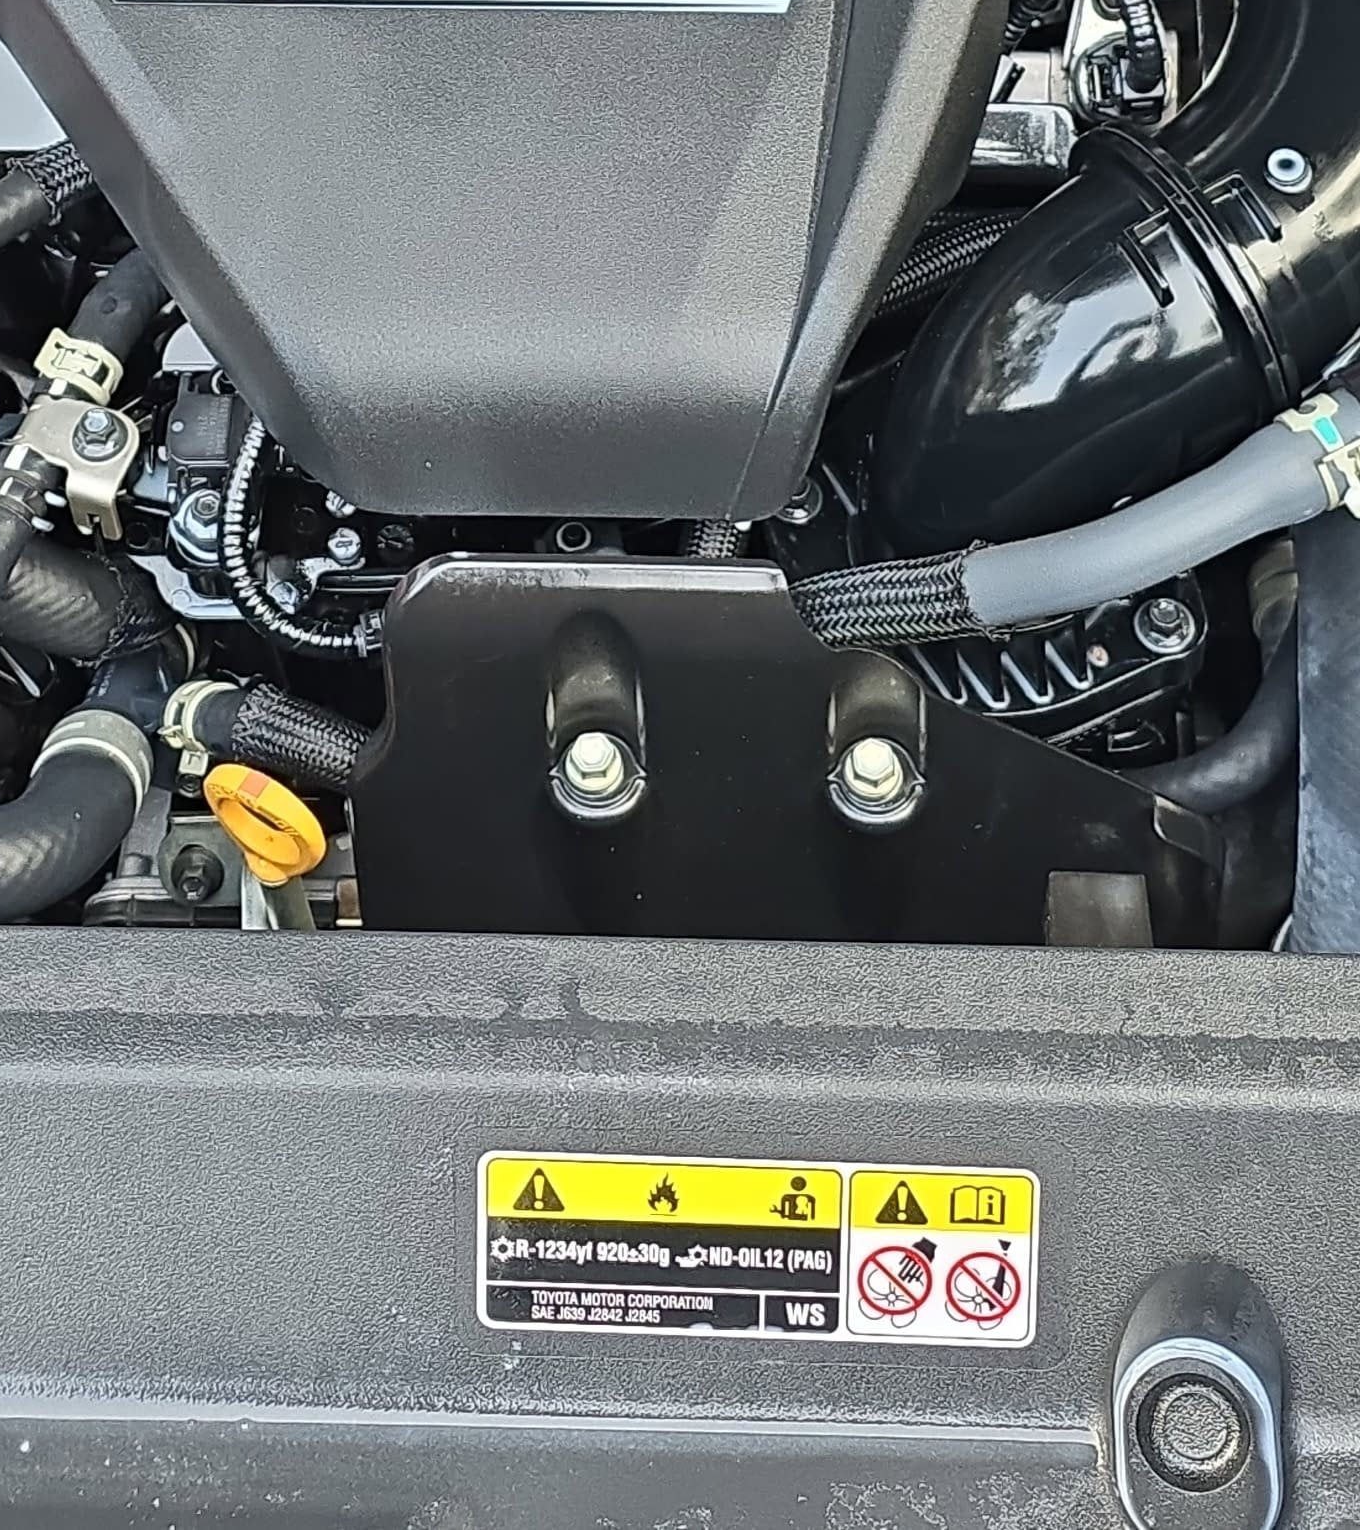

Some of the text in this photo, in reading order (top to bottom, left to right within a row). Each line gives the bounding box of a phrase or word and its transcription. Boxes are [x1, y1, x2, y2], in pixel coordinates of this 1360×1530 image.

[515, 1239, 833, 1274] R-1234yf 920±30g ND-OIL12 (PAG)
[531, 1290, 714, 1311] TOYOTA MOTOR CORPORATION
[531, 1306, 661, 1323] SAE J639 J2842 J2845
[785, 1302, 826, 1326] WS
